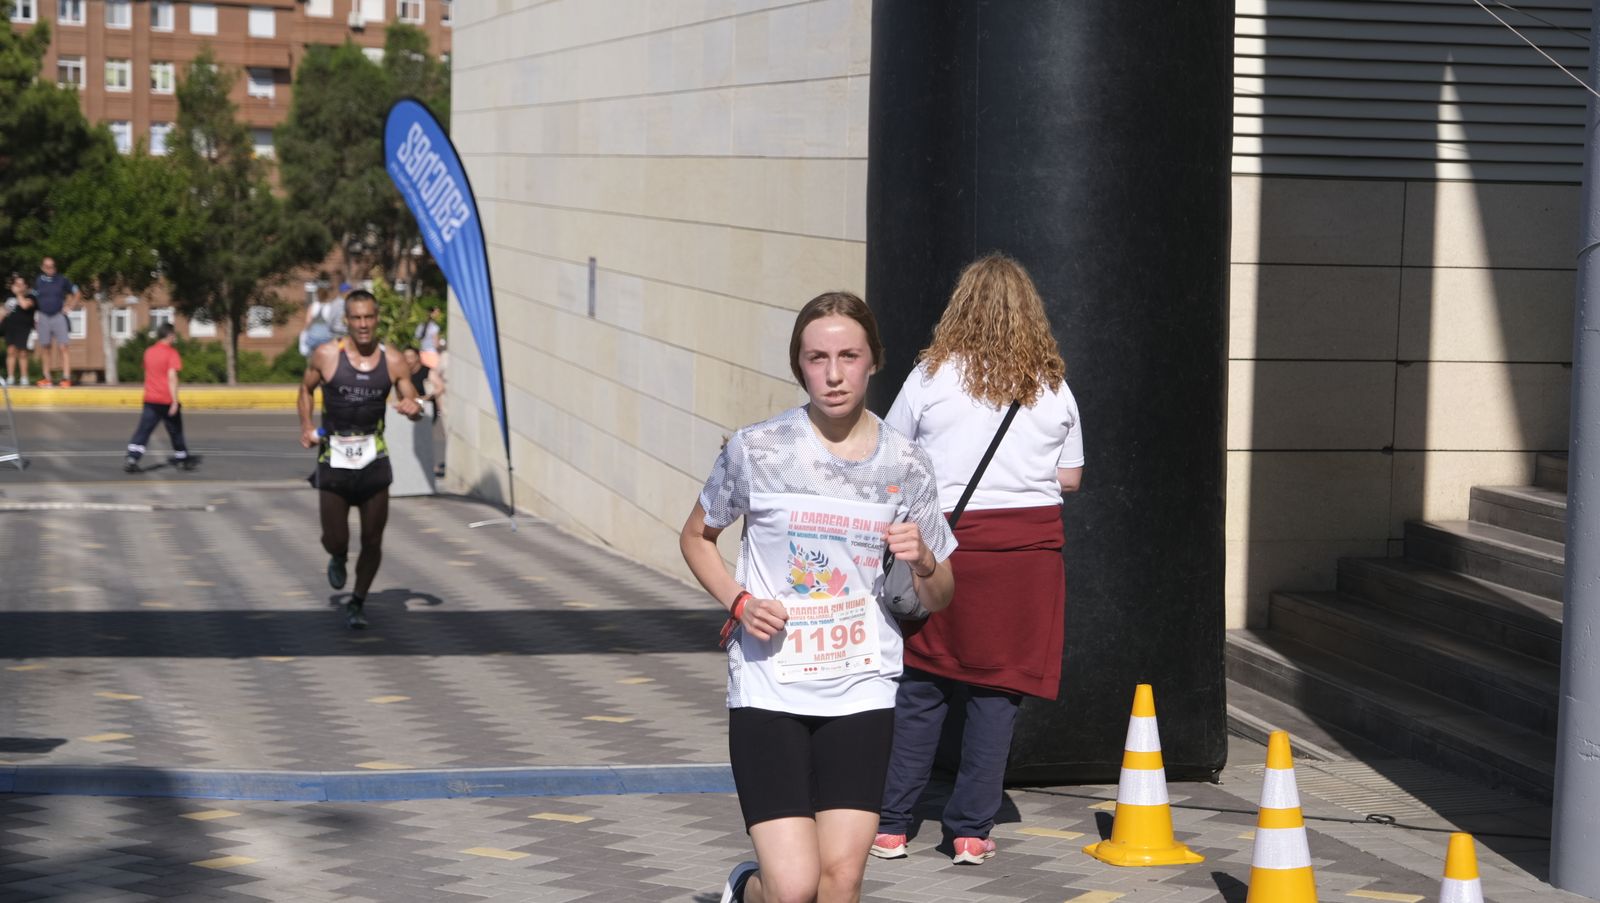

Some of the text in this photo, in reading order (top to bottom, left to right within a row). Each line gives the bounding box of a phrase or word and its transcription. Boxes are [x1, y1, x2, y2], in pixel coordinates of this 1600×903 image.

[345, 447, 362, 458] 84
[790, 511, 798, 522] II
[801, 512, 849, 528] CARRERA
[852, 518, 871, 531] SIN
[818, 526, 848, 535] SALUDABLE
[790, 606, 829, 615] CARRERA
[831, 601, 844, 613] SIN
[845, 599, 866, 609] HUMO
[788, 621, 866, 653] 1196
[814, 651, 846, 661] MARTINA
